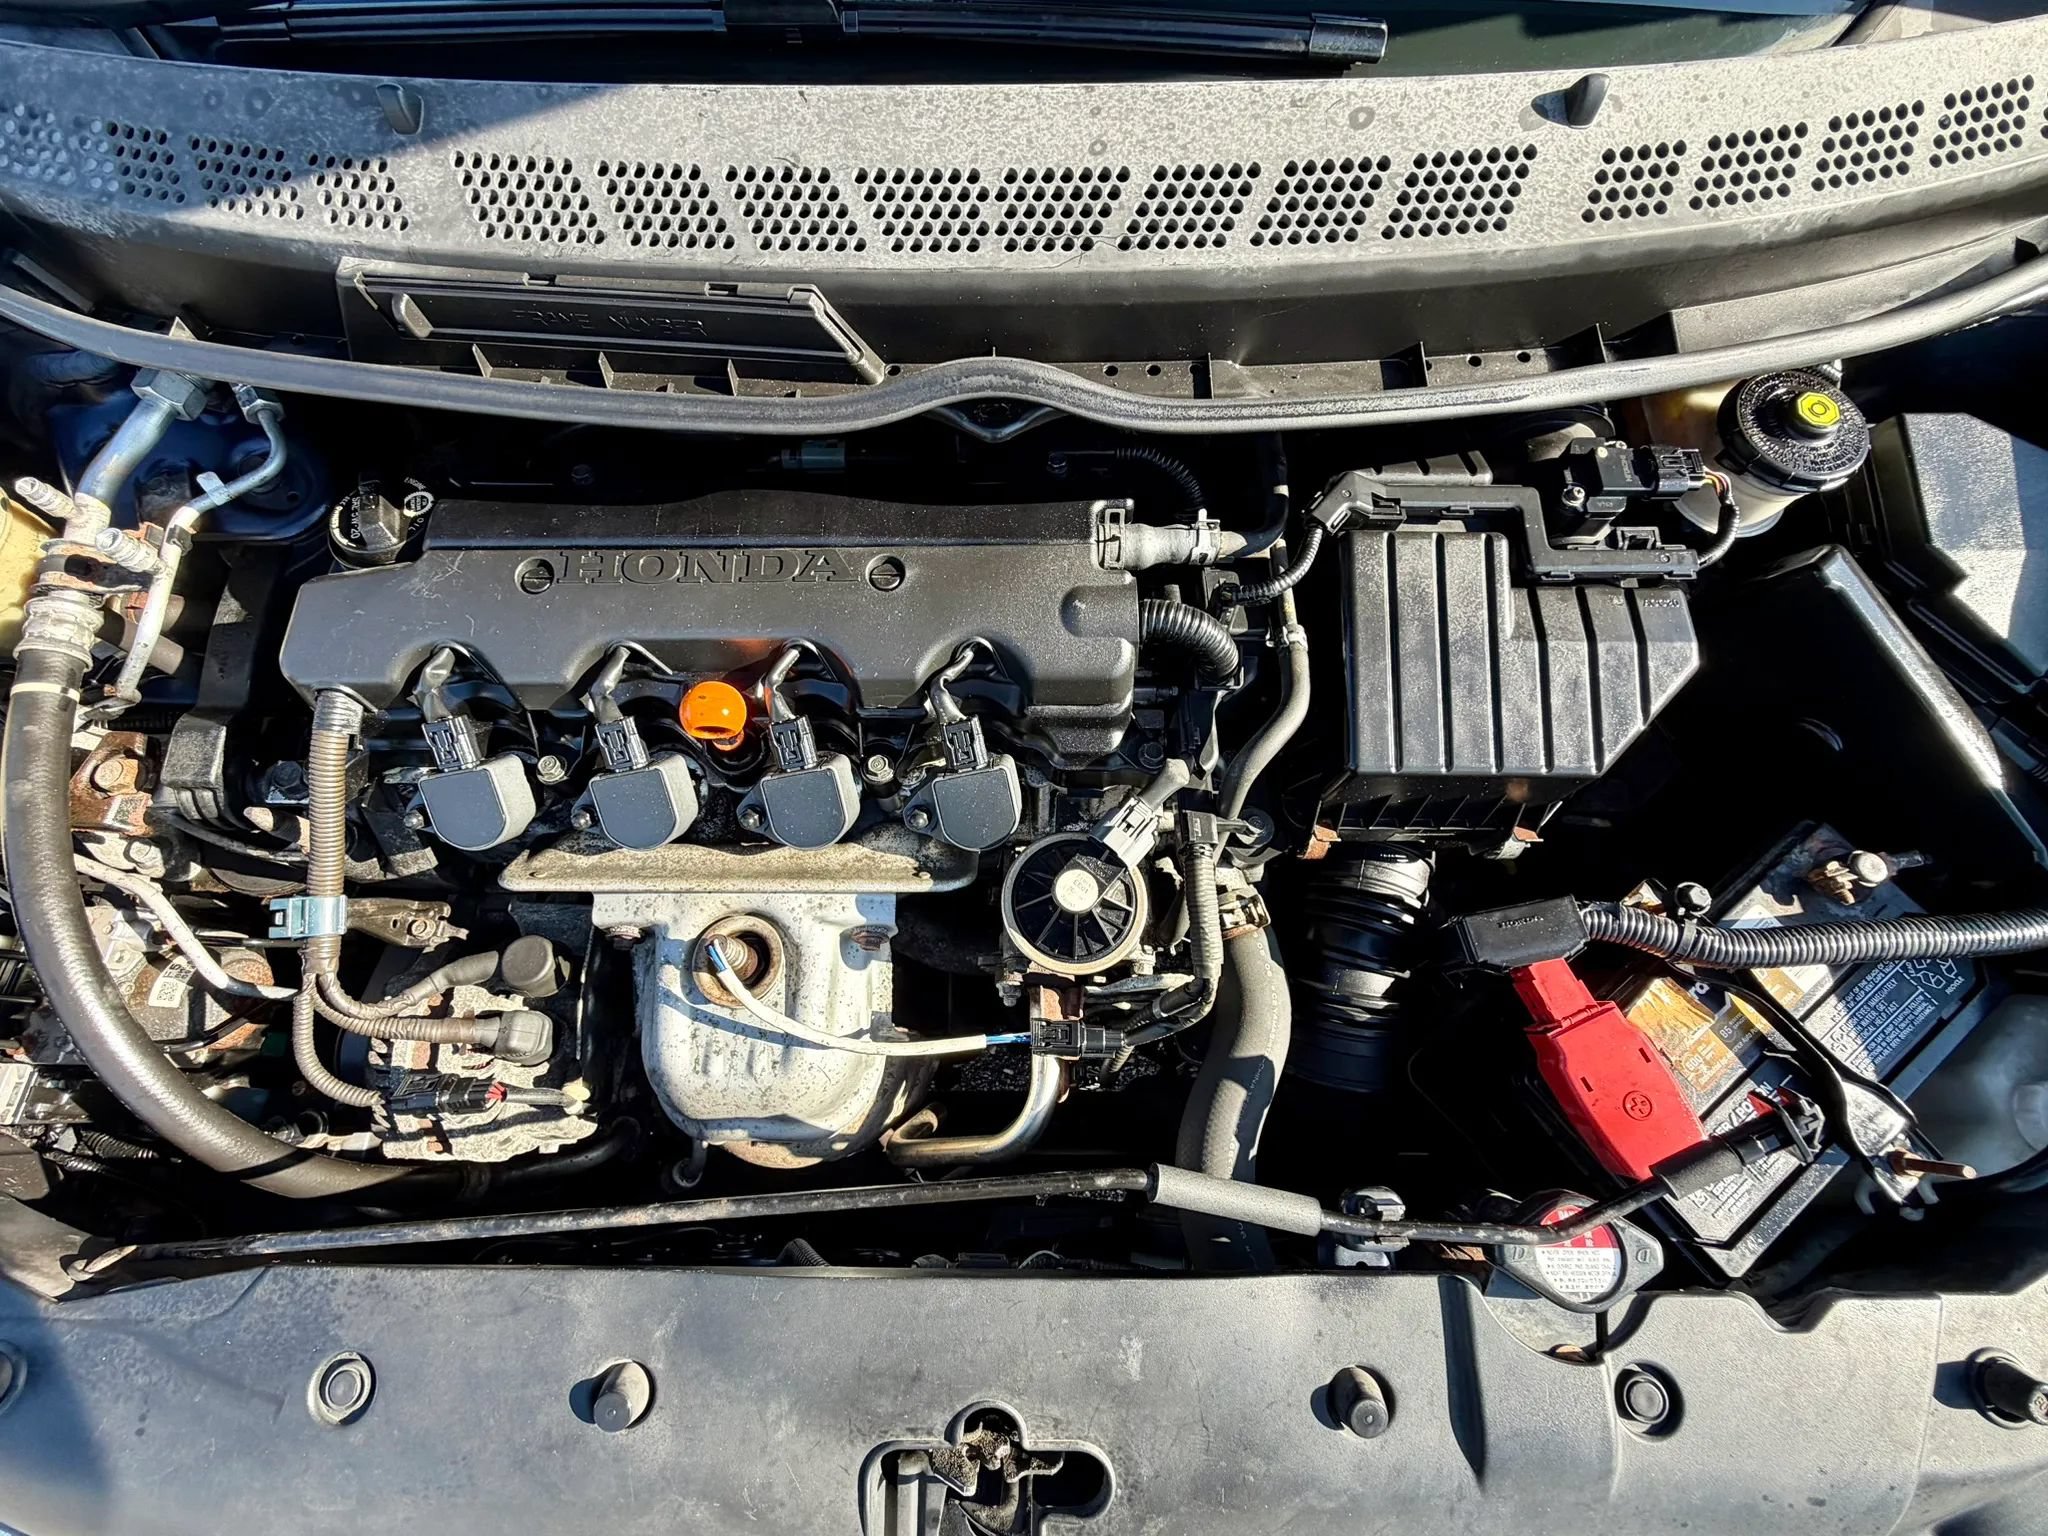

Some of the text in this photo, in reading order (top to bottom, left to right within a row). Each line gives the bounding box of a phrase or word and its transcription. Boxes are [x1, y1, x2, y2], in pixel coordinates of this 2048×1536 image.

[557, 550, 861, 585] HONDA
[1855, 1003, 1871, 1019] EYES
[1867, 977, 1898, 1008] IMMEDIATELY
[1944, 975, 1965, 995] RECYCLE
[1853, 1000, 1899, 1045] MEDICAL HELP FAST
[1875, 999, 1888, 1012] GET
